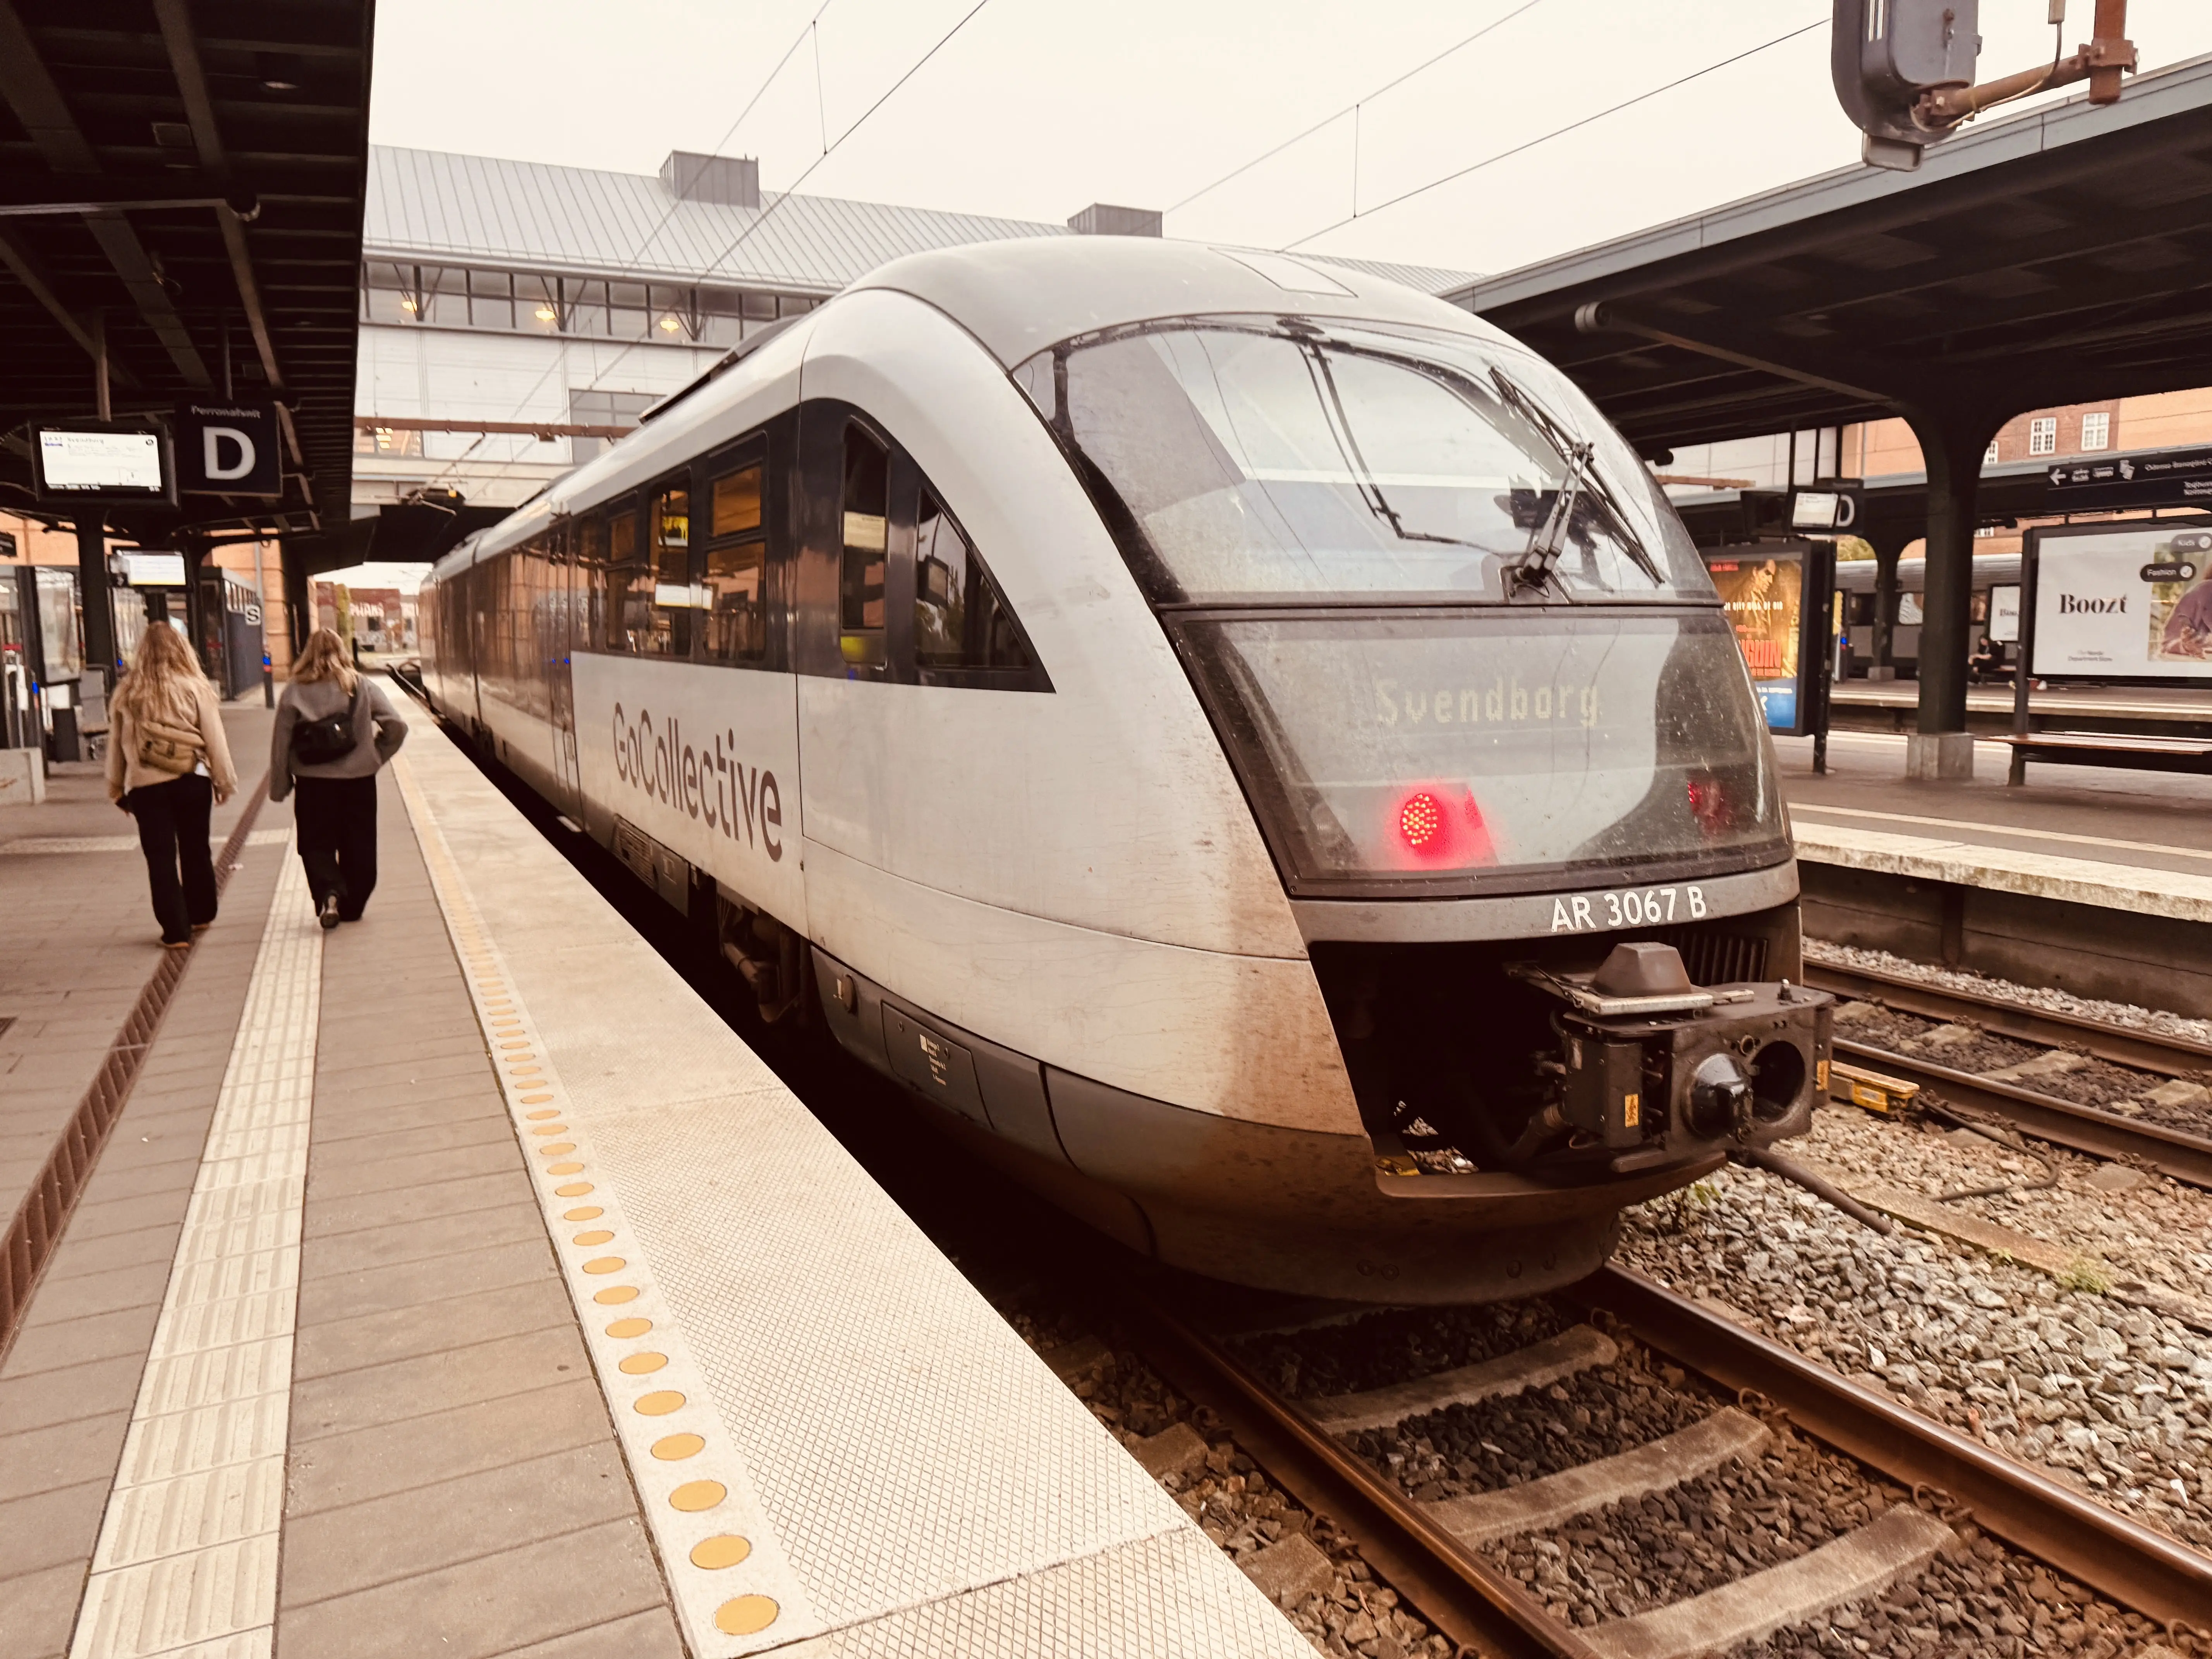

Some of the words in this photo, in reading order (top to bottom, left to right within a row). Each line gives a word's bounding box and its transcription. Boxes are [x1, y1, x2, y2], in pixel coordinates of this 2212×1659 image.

[203, 426, 256, 479] D
[2059, 593, 2128, 614] Boozt
[1374, 676, 1600, 727] Svendborg
[613, 702, 782, 862] GoCollective
[1551, 896, 1596, 932] AR
[1604, 888, 1676, 926] 3067
[1687, 886, 1706, 918] B
